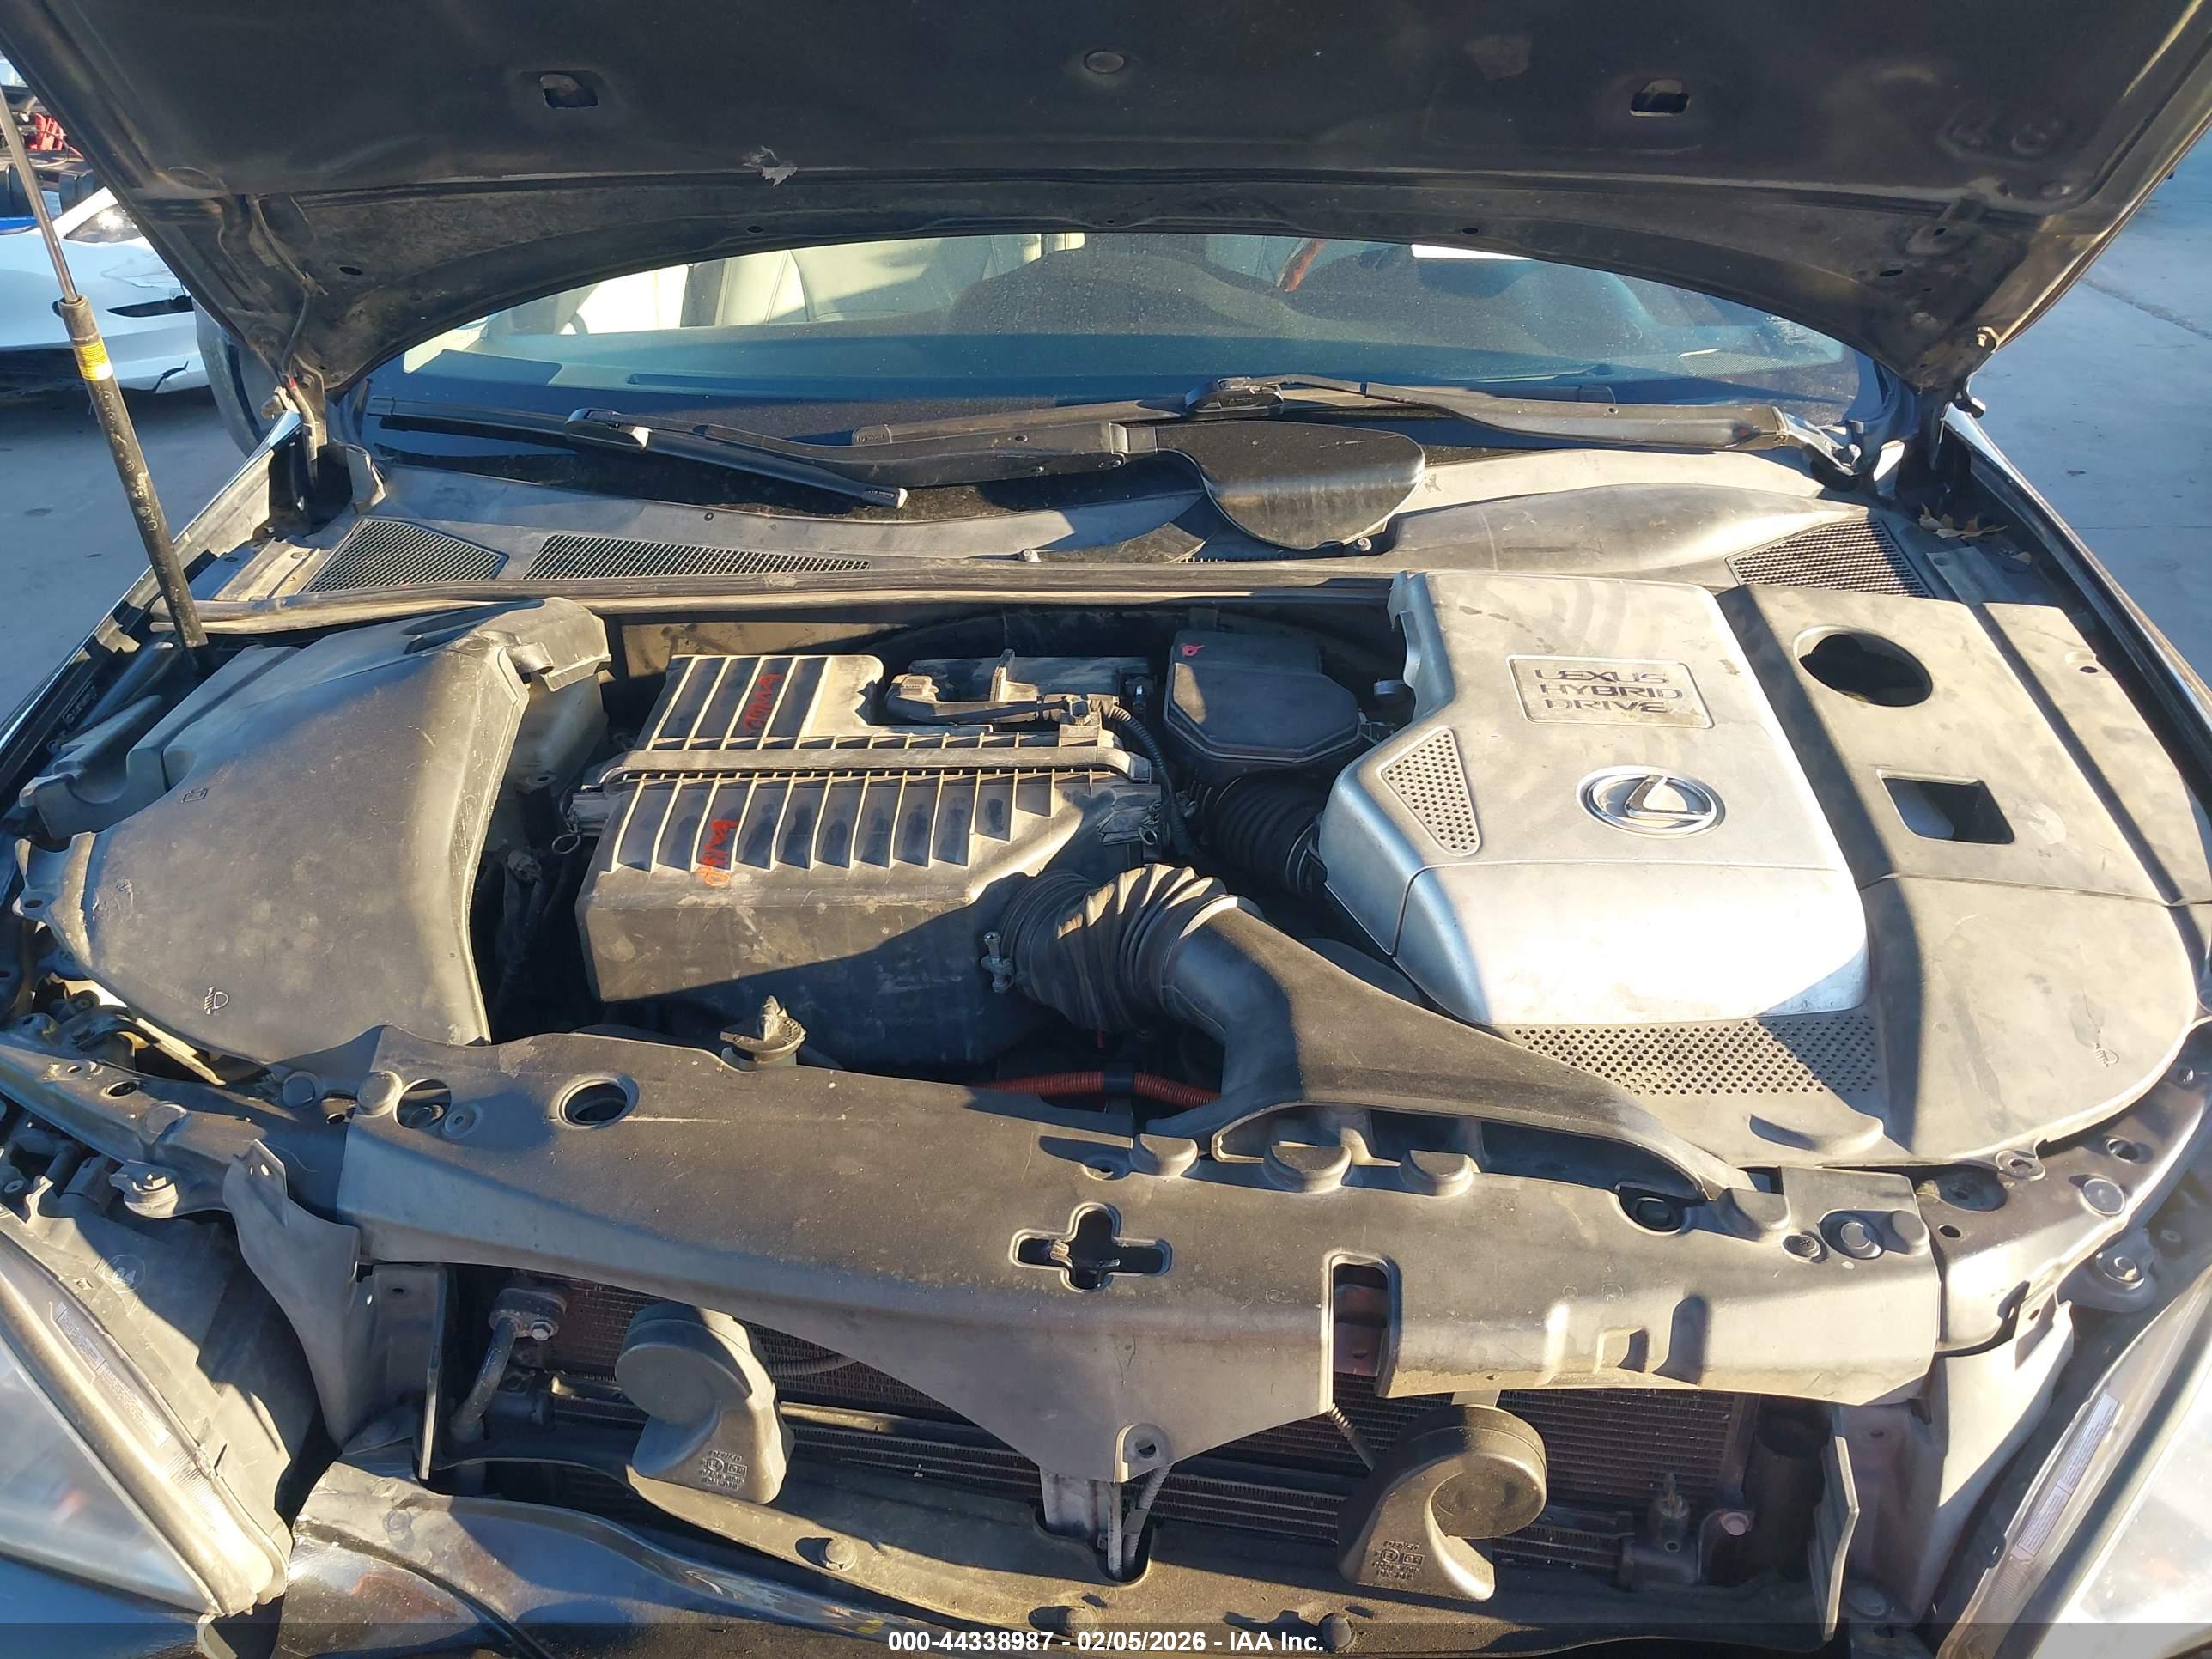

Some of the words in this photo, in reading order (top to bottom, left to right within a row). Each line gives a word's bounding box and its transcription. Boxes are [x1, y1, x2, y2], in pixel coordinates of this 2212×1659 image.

[1534, 669, 1669, 684] LEXUS
[1540, 684, 1683, 699] HYBRID
[1545, 699, 1668, 713] DRIVE
